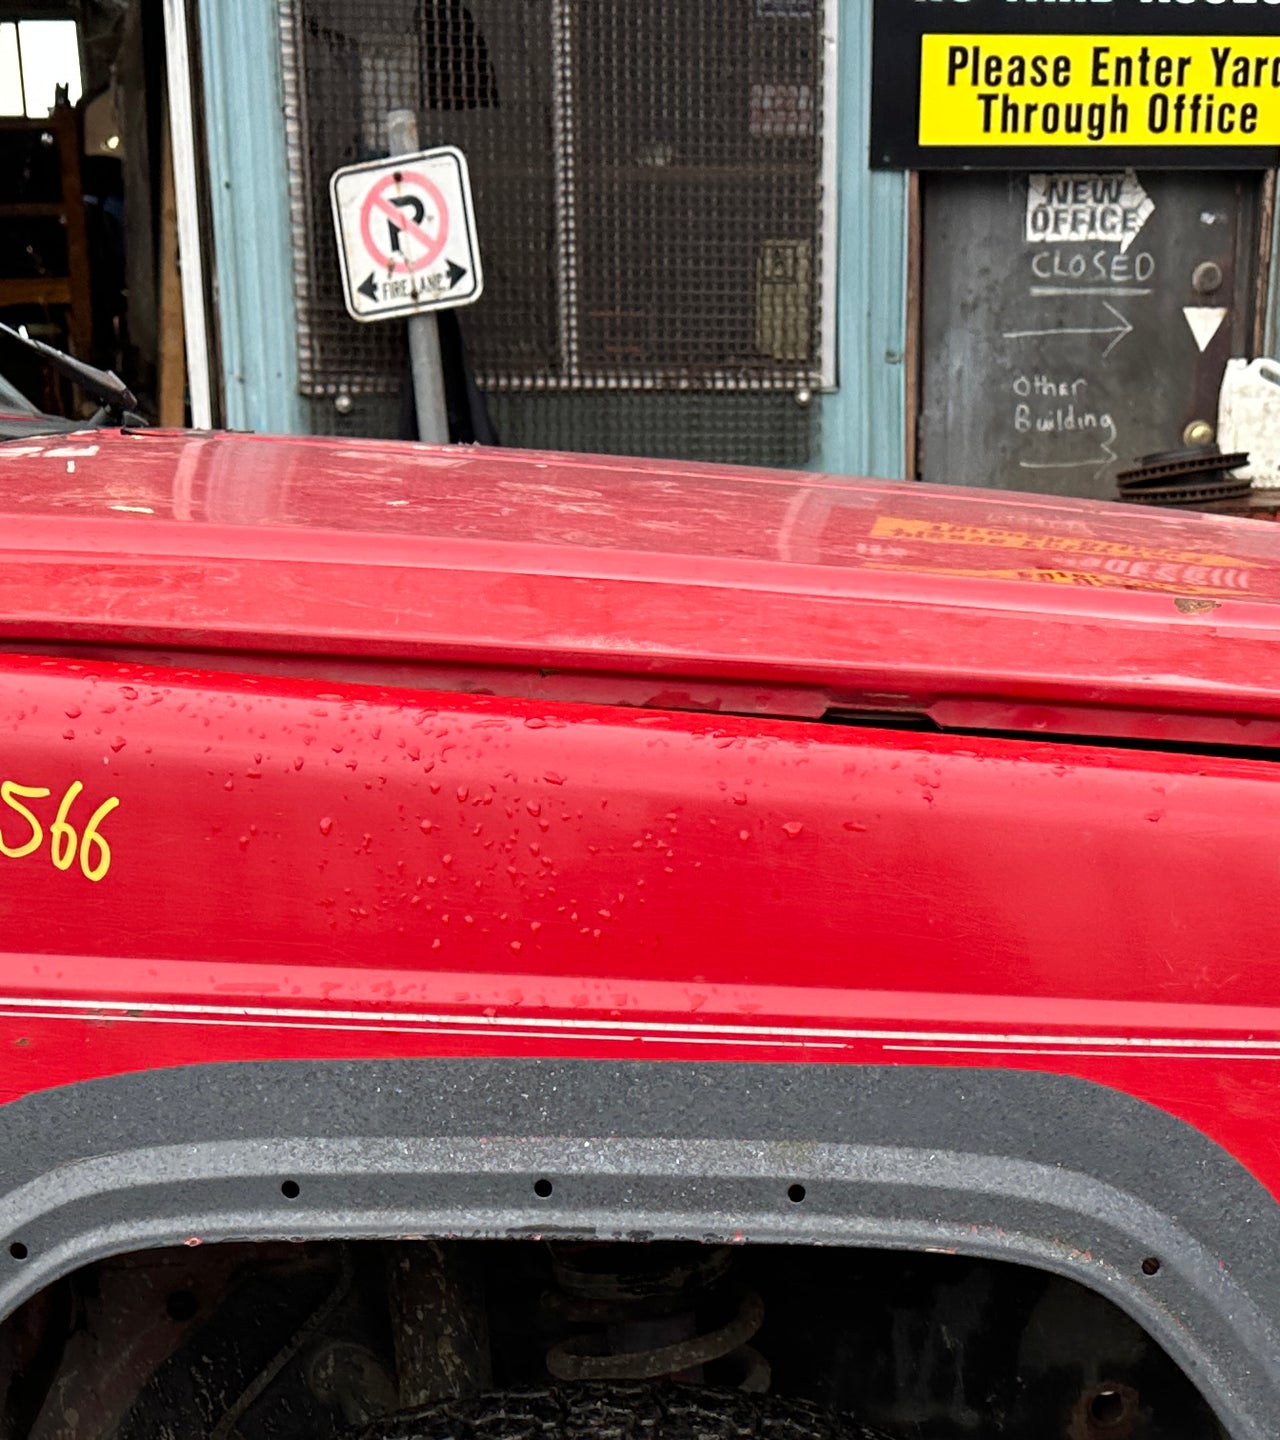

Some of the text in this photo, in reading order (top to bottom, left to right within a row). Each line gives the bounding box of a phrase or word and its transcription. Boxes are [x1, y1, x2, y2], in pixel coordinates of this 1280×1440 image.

[946, 45, 1071, 87] Please
[1091, 46, 1192, 88] Enter
[977, 93, 1258, 140] Through Office
[1045, 179, 1122, 204] NEW
[1031, 204, 1138, 234] OFFICE
[1031, 250, 1155, 282] CLOSED
[1012, 373, 1088, 402] Other
[1014, 403, 1118, 446] Building
